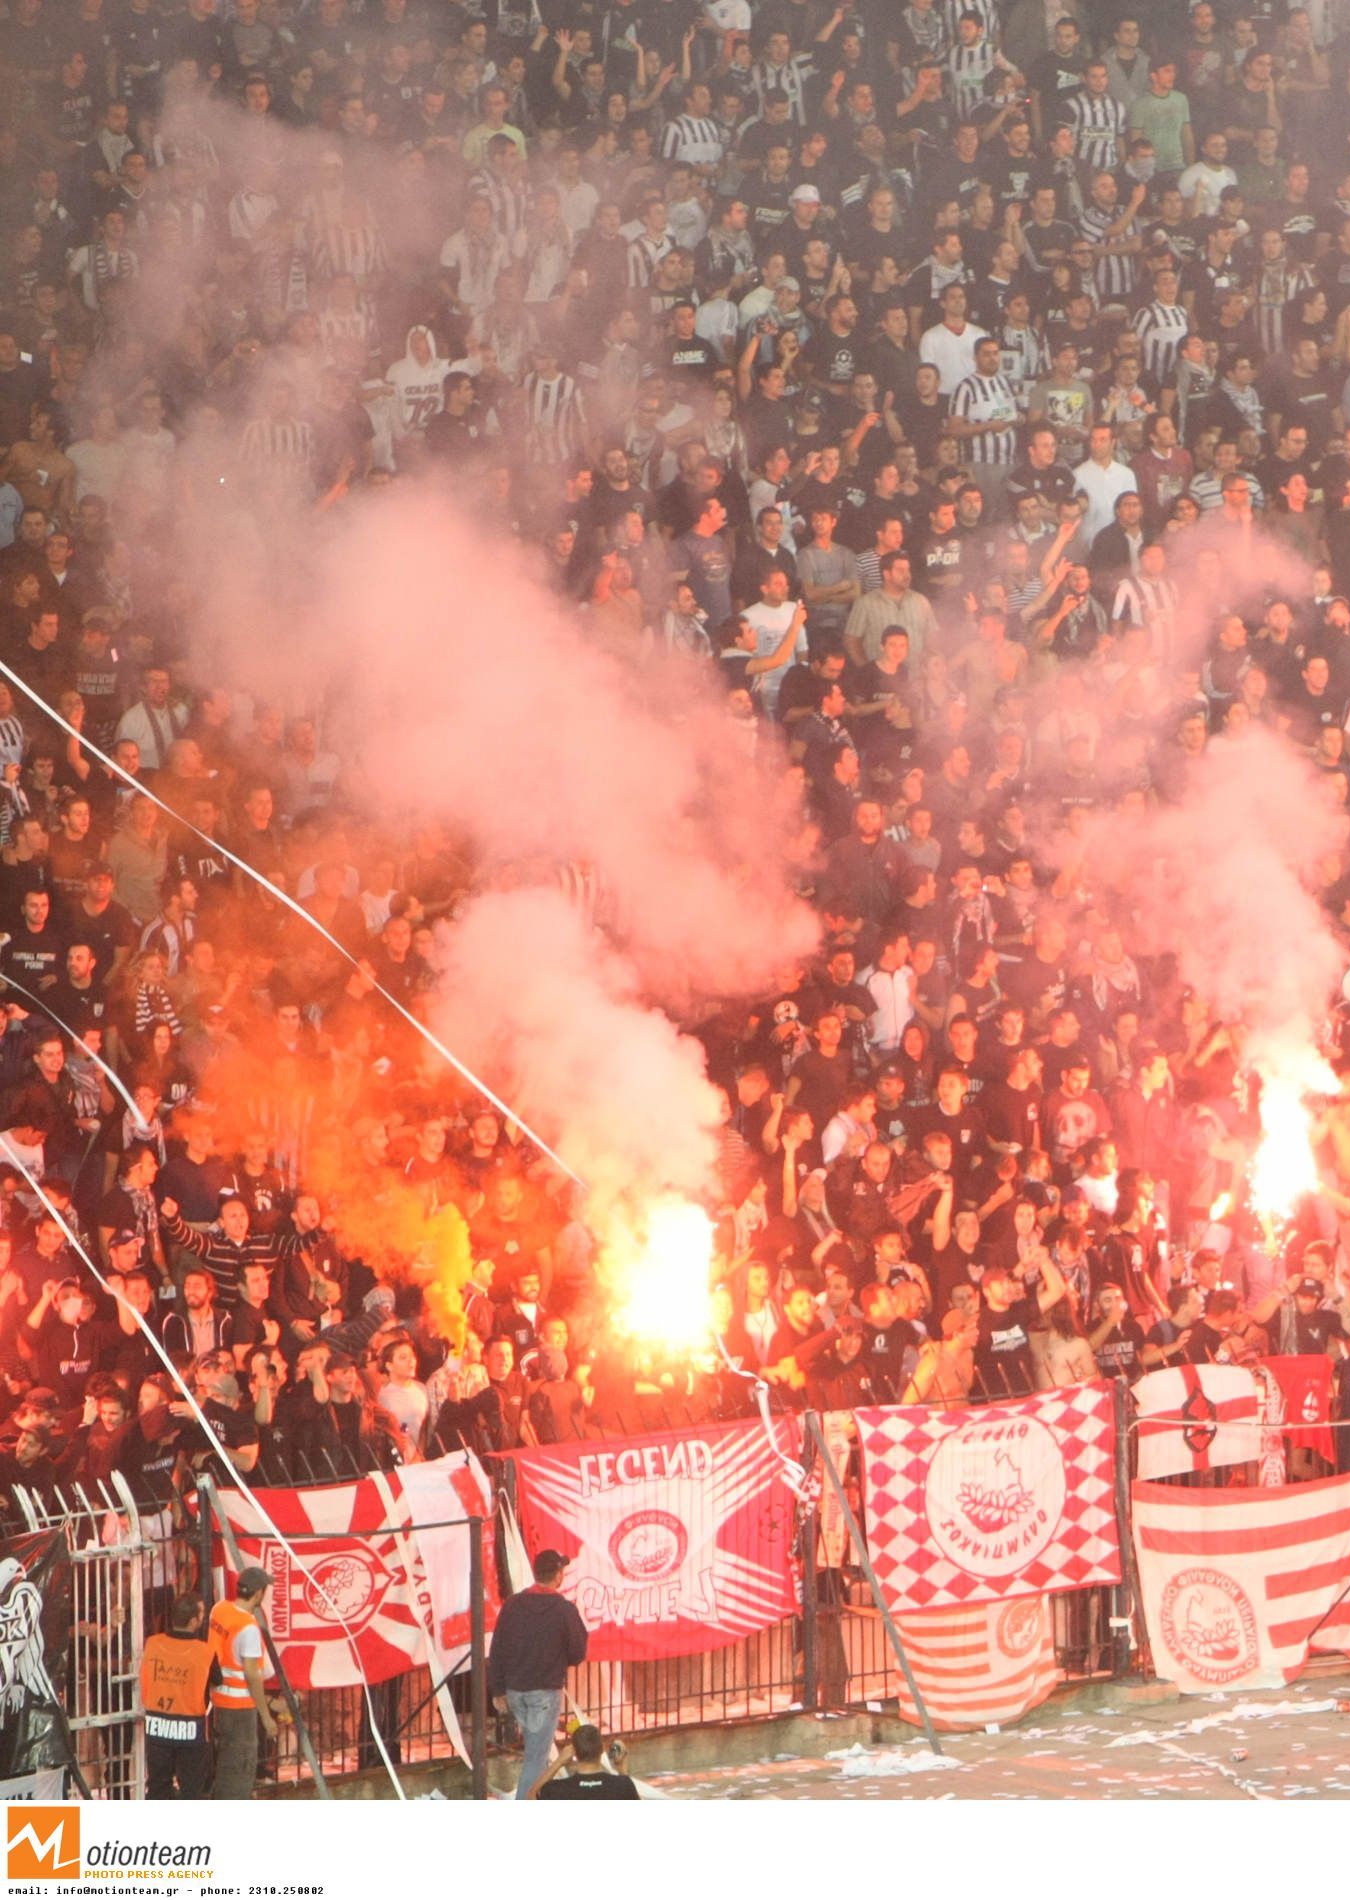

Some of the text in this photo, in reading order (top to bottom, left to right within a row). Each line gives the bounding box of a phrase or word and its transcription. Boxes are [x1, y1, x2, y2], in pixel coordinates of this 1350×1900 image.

[271, 1549, 288, 1633] ΟΛΥΜΠΙΑΚΟΣ
[157, 1696, 175, 1711] 47
[144, 1715, 197, 1740] TEWARD
